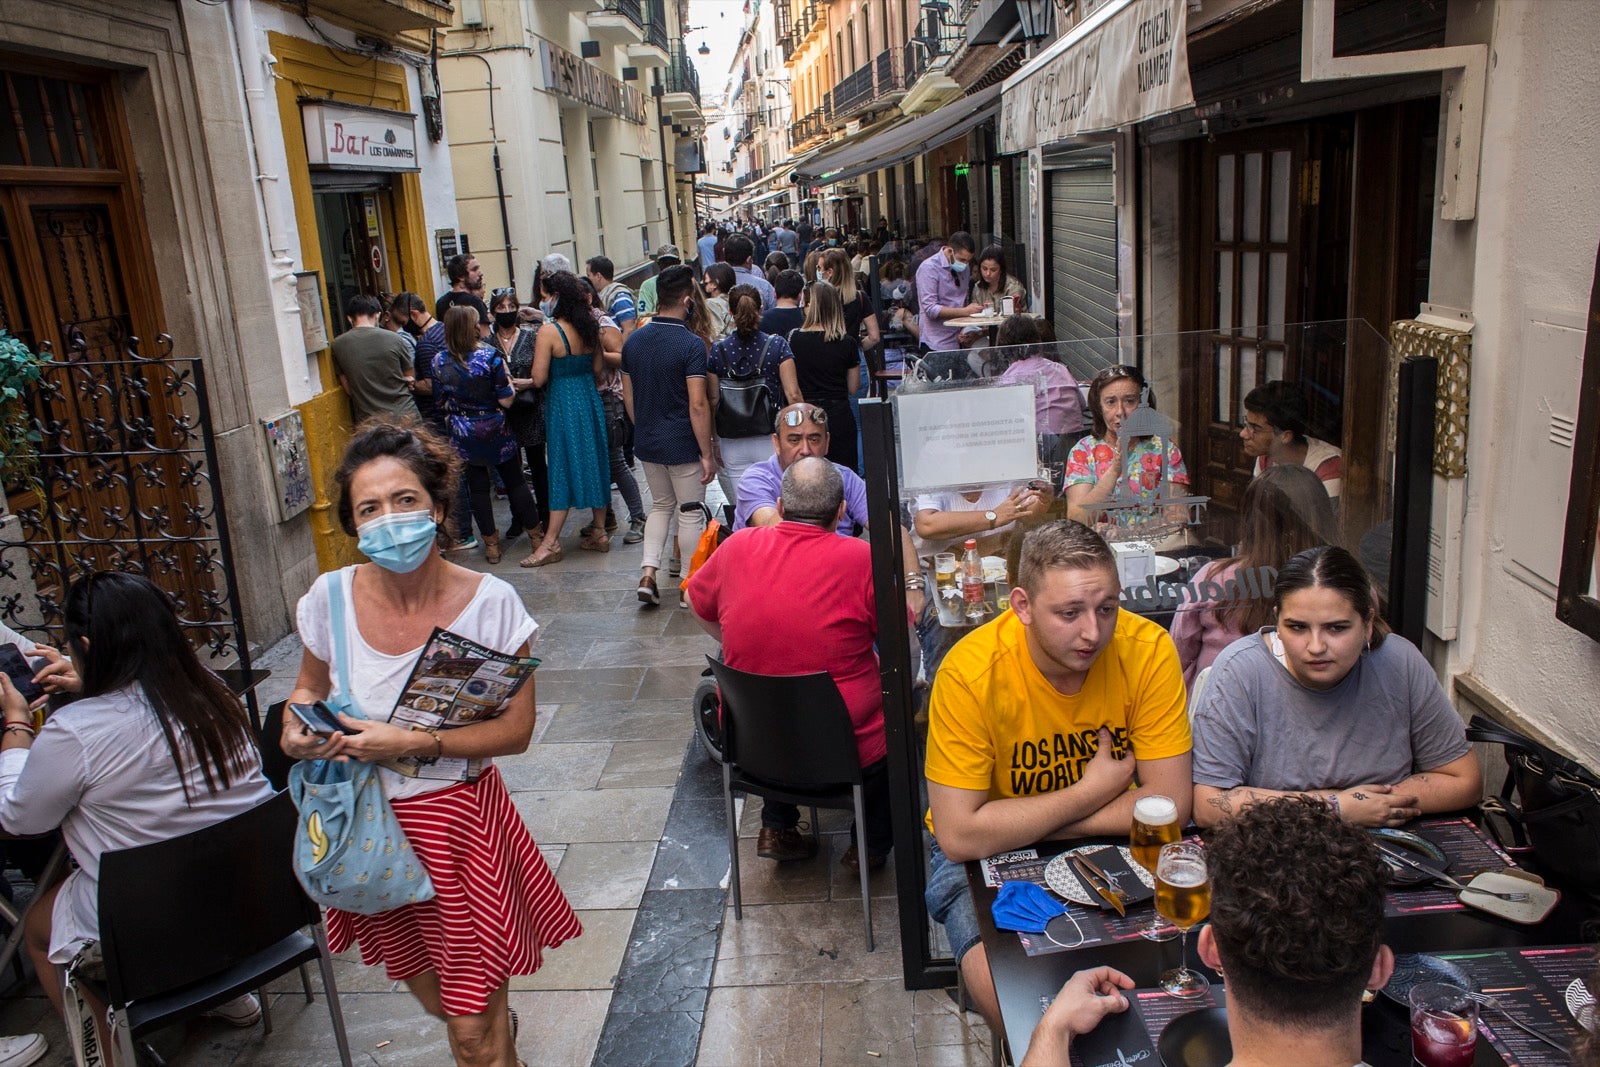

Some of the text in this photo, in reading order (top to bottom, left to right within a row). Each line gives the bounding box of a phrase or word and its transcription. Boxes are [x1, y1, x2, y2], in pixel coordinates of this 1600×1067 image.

[330, 122, 369, 155] Bar
[369, 146, 414, 159] LOS DIAMANTES
[1010, 738, 1052, 771] LOS
